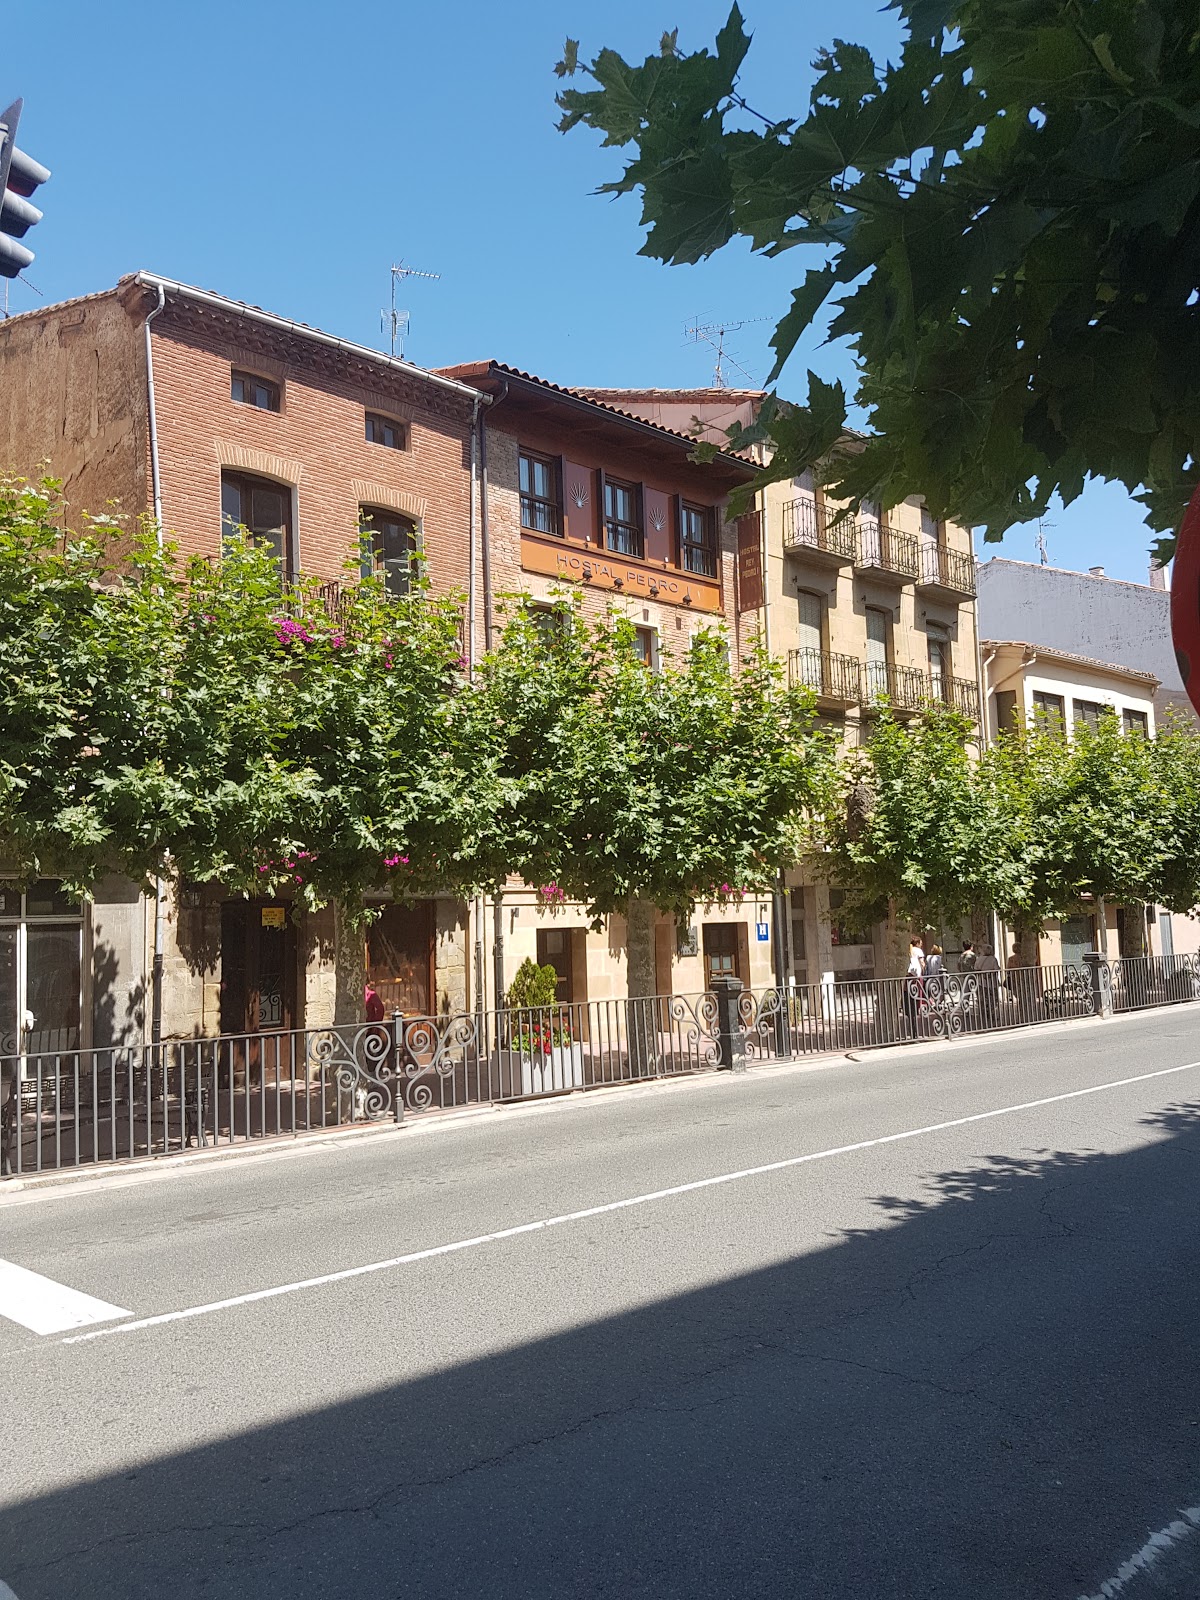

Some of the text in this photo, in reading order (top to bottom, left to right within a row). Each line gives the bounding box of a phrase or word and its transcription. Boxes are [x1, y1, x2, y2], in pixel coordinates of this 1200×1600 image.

[740, 544, 760, 556] HOSTAL
[745, 557, 755, 568] REY
[556, 552, 618, 579] HOSTAL
[626, 571, 679, 593] PEDRO
